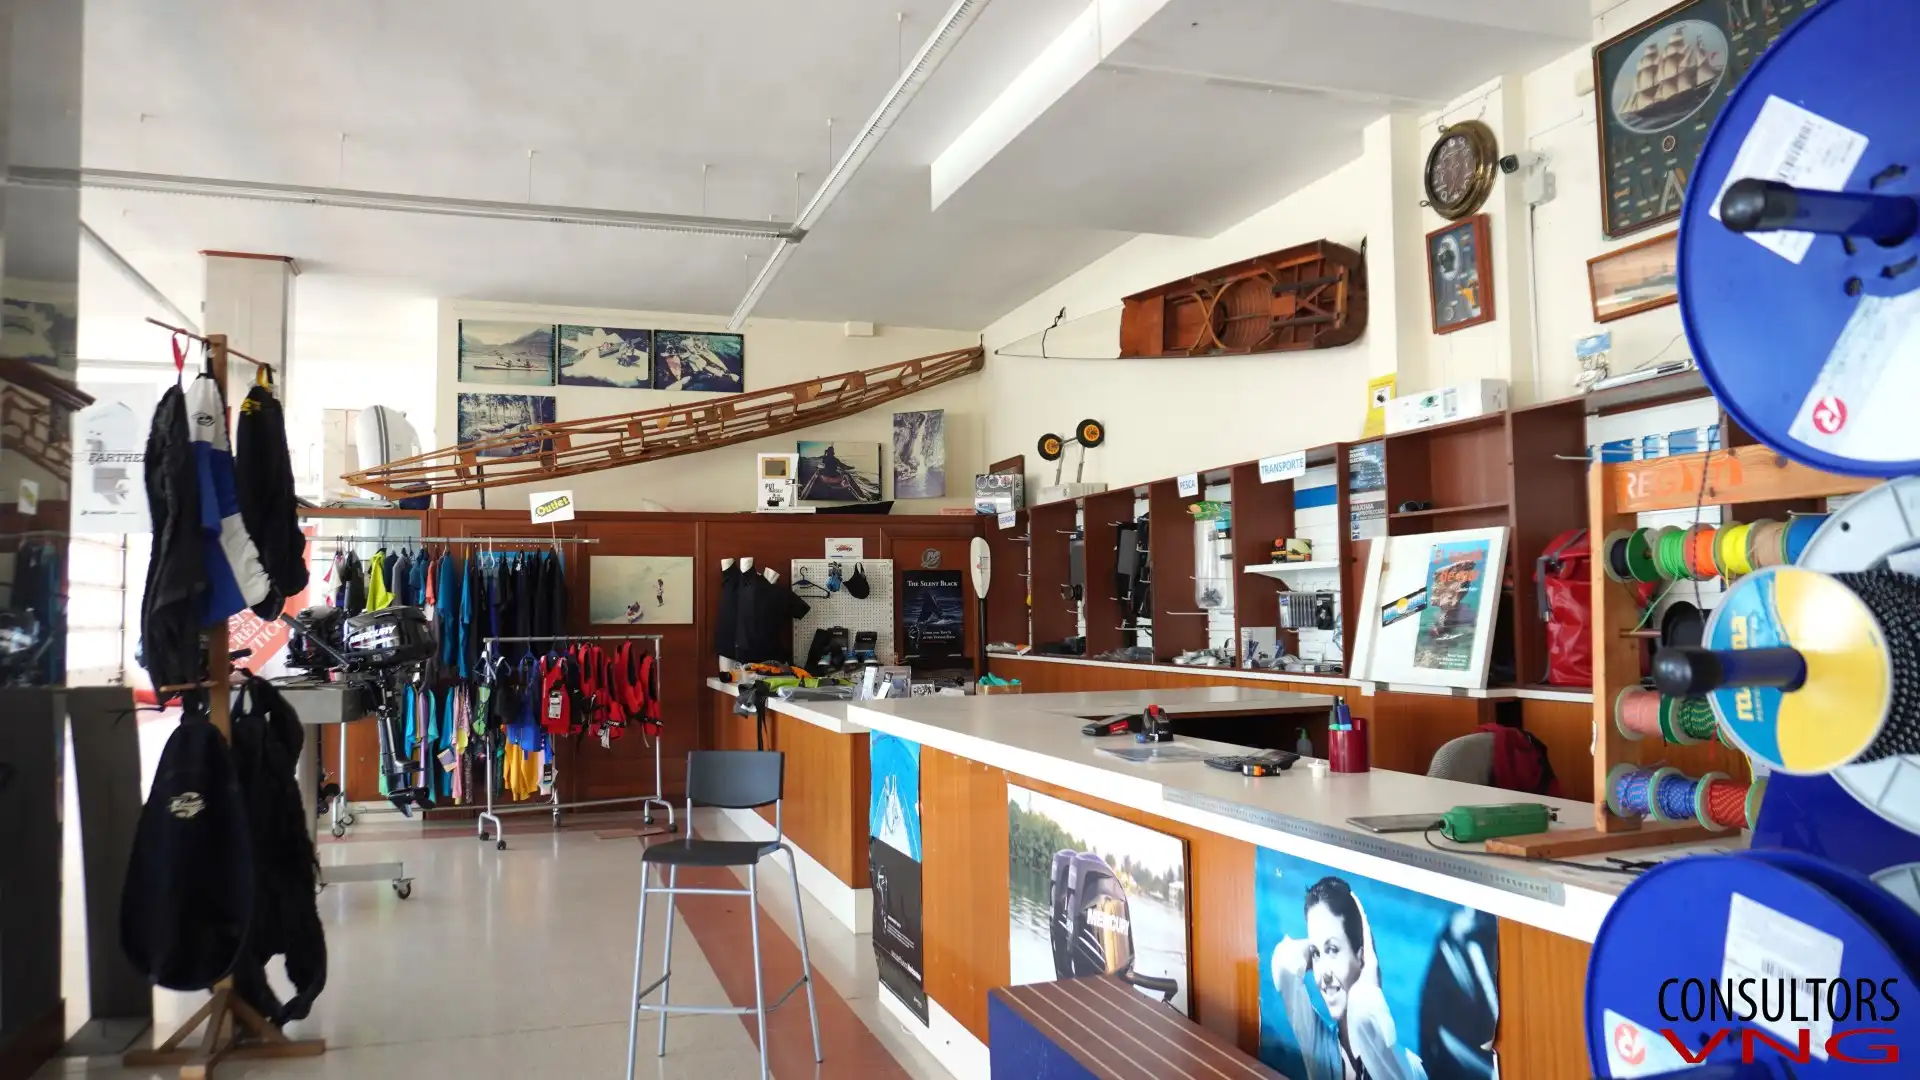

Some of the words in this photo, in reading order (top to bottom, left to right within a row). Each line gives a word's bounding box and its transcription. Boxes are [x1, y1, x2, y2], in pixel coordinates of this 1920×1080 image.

[1261, 458, 1304, 476] TRANSPORTE
[1180, 480, 1195, 490] PESCA
[536, 496, 570, 517] Outlet
[350, 625, 397, 643] MERCURY
[1087, 907, 1130, 936] MERCURY
